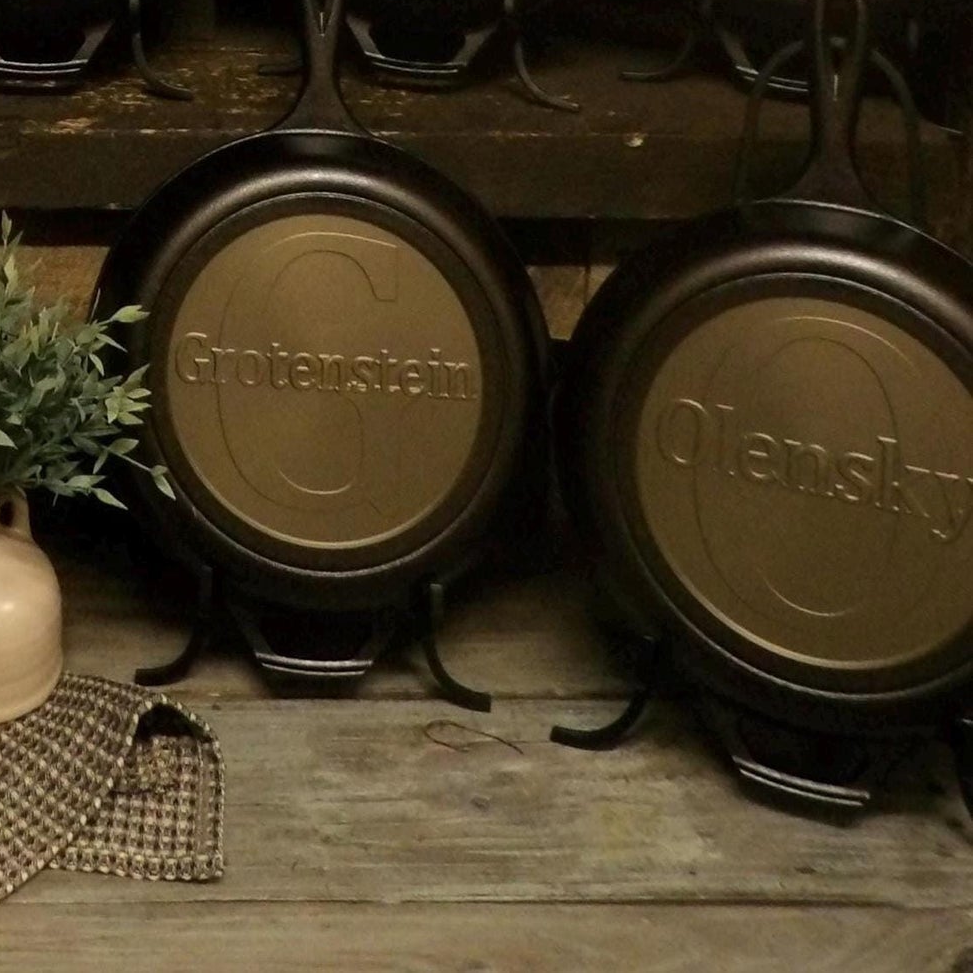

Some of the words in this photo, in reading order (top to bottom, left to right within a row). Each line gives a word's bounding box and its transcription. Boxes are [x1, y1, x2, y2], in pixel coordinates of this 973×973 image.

[176, 331, 478, 401] Grotenstein
[217, 231, 413, 517] G
[657, 398, 973, 545] Olensky
[694, 315, 945, 632] O
